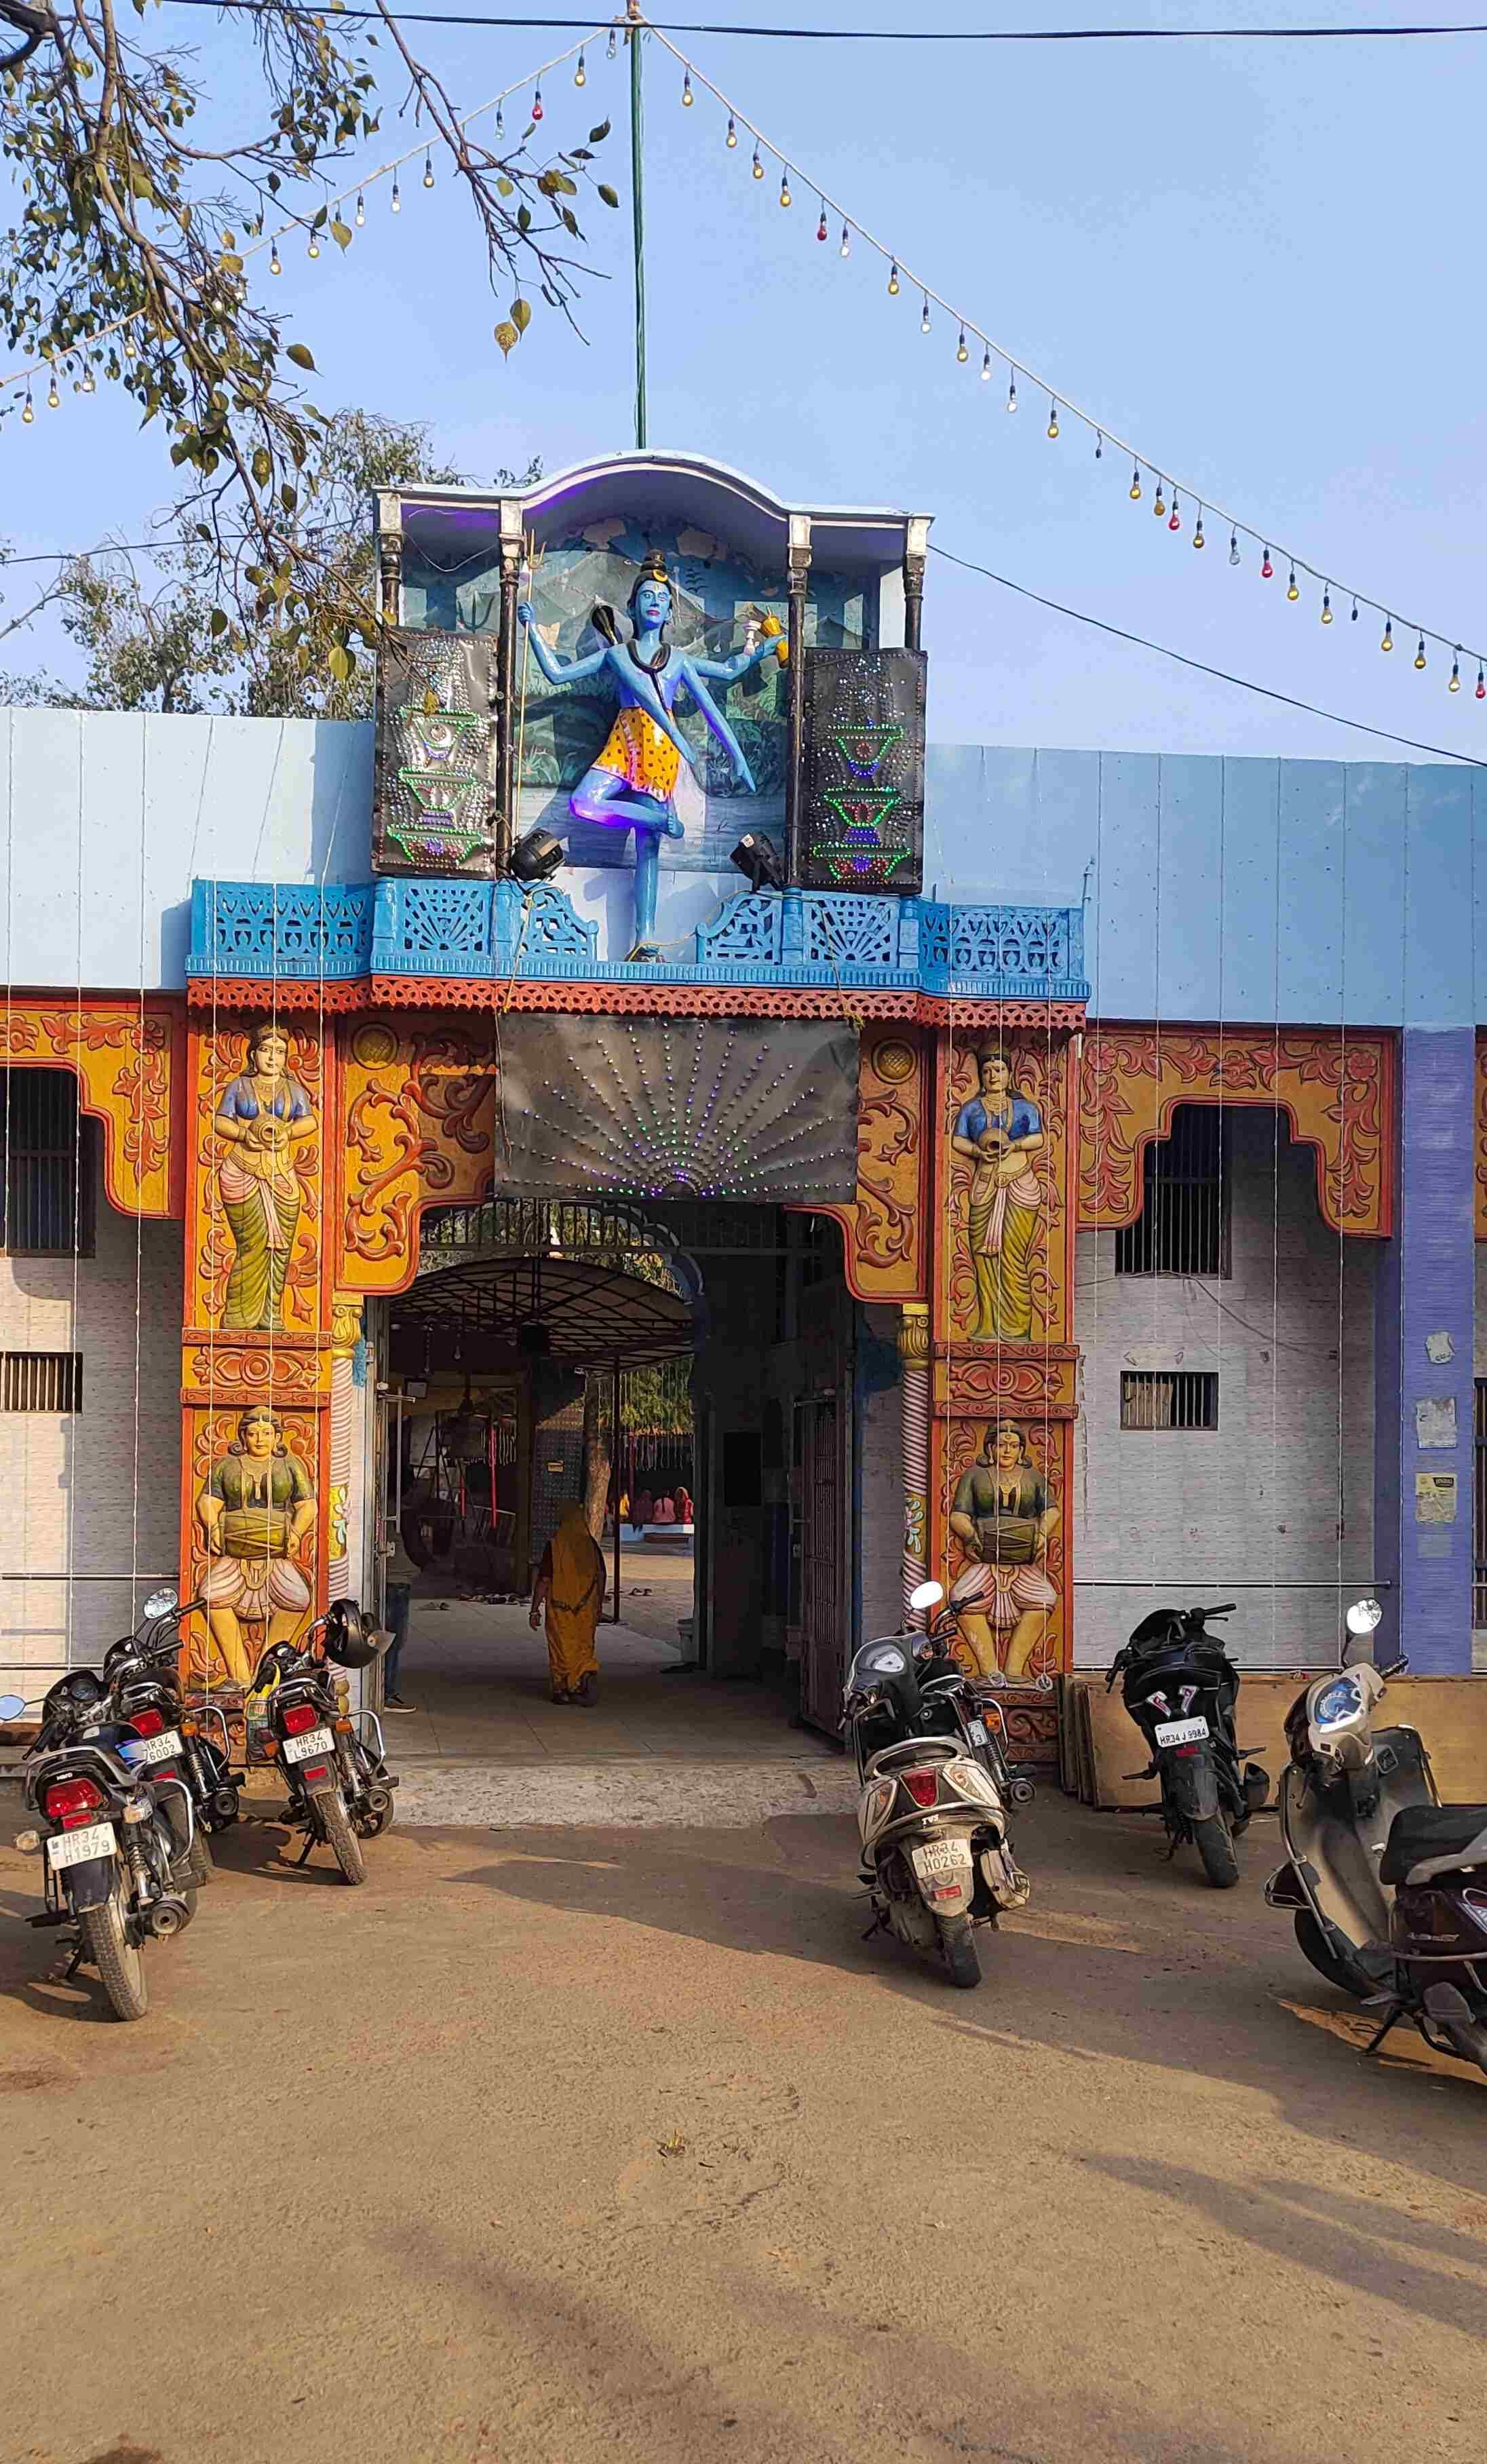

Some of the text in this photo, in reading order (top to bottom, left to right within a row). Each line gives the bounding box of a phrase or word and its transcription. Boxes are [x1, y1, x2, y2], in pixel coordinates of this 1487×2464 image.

[295, 1731, 322, 1747] HR34
[149, 1744, 176, 1761] 6002
[294, 1741, 327, 1758] L9670
[922, 1813, 939, 1825] TVS
[64, 1828, 99, 1846] HR34
[65, 1840, 110, 1863] H1979
[923, 1853, 966, 1872] H0262
